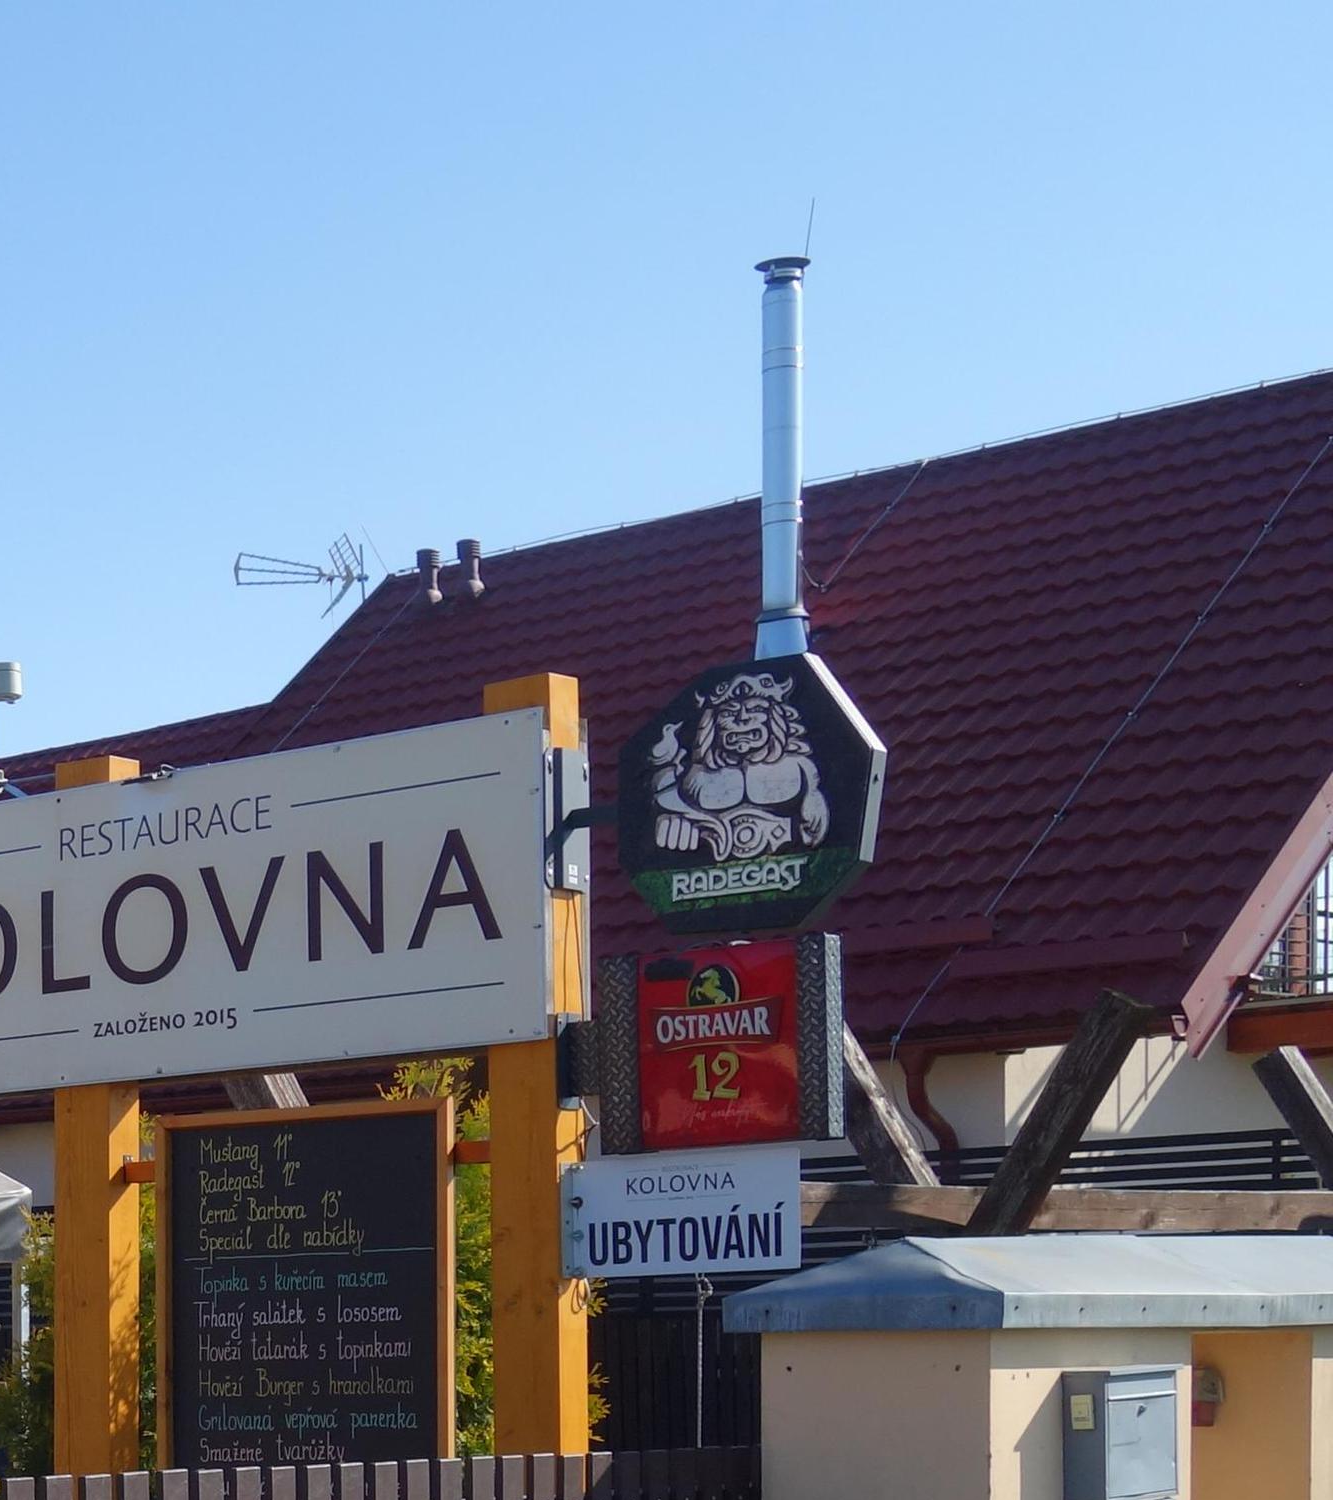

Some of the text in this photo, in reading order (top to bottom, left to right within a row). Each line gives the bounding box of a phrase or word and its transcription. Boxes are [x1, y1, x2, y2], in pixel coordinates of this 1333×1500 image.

[58, 795, 273, 862] RESTAURACE
[672, 856, 809, 902] RADEGAST
[93, 1007, 238, 1038] ZALOŽENO 2015
[655, 1006, 771, 1044] OSTRAVAR
[688, 1051, 740, 1101] 12
[199, 1136, 259, 1169] Mustang
[199, 1164, 265, 1202] Radegast
[626, 1171, 735, 1196] KOLOVNA
[199, 1196, 238, 1225] Černá
[246, 1196, 307, 1222] Barbora
[199, 1218, 365, 1264] Speciál dle nabídky
[588, 1202, 783, 1266] UBYTOVÁNÍ
[194, 1262, 388, 1304] Topinka s kuřecím masem
[193, 1294, 402, 1339] Trhaný salátek s lososem
[198, 1330, 412, 1374] Hovězí tatarák s topinkami
[198, 1366, 414, 1406] Hovězí Burger s hranolkami
[198, 1402, 418, 1440] Grilovaná vepřová panenka
[199, 1432, 345, 1463] Smažené tvarůžky
